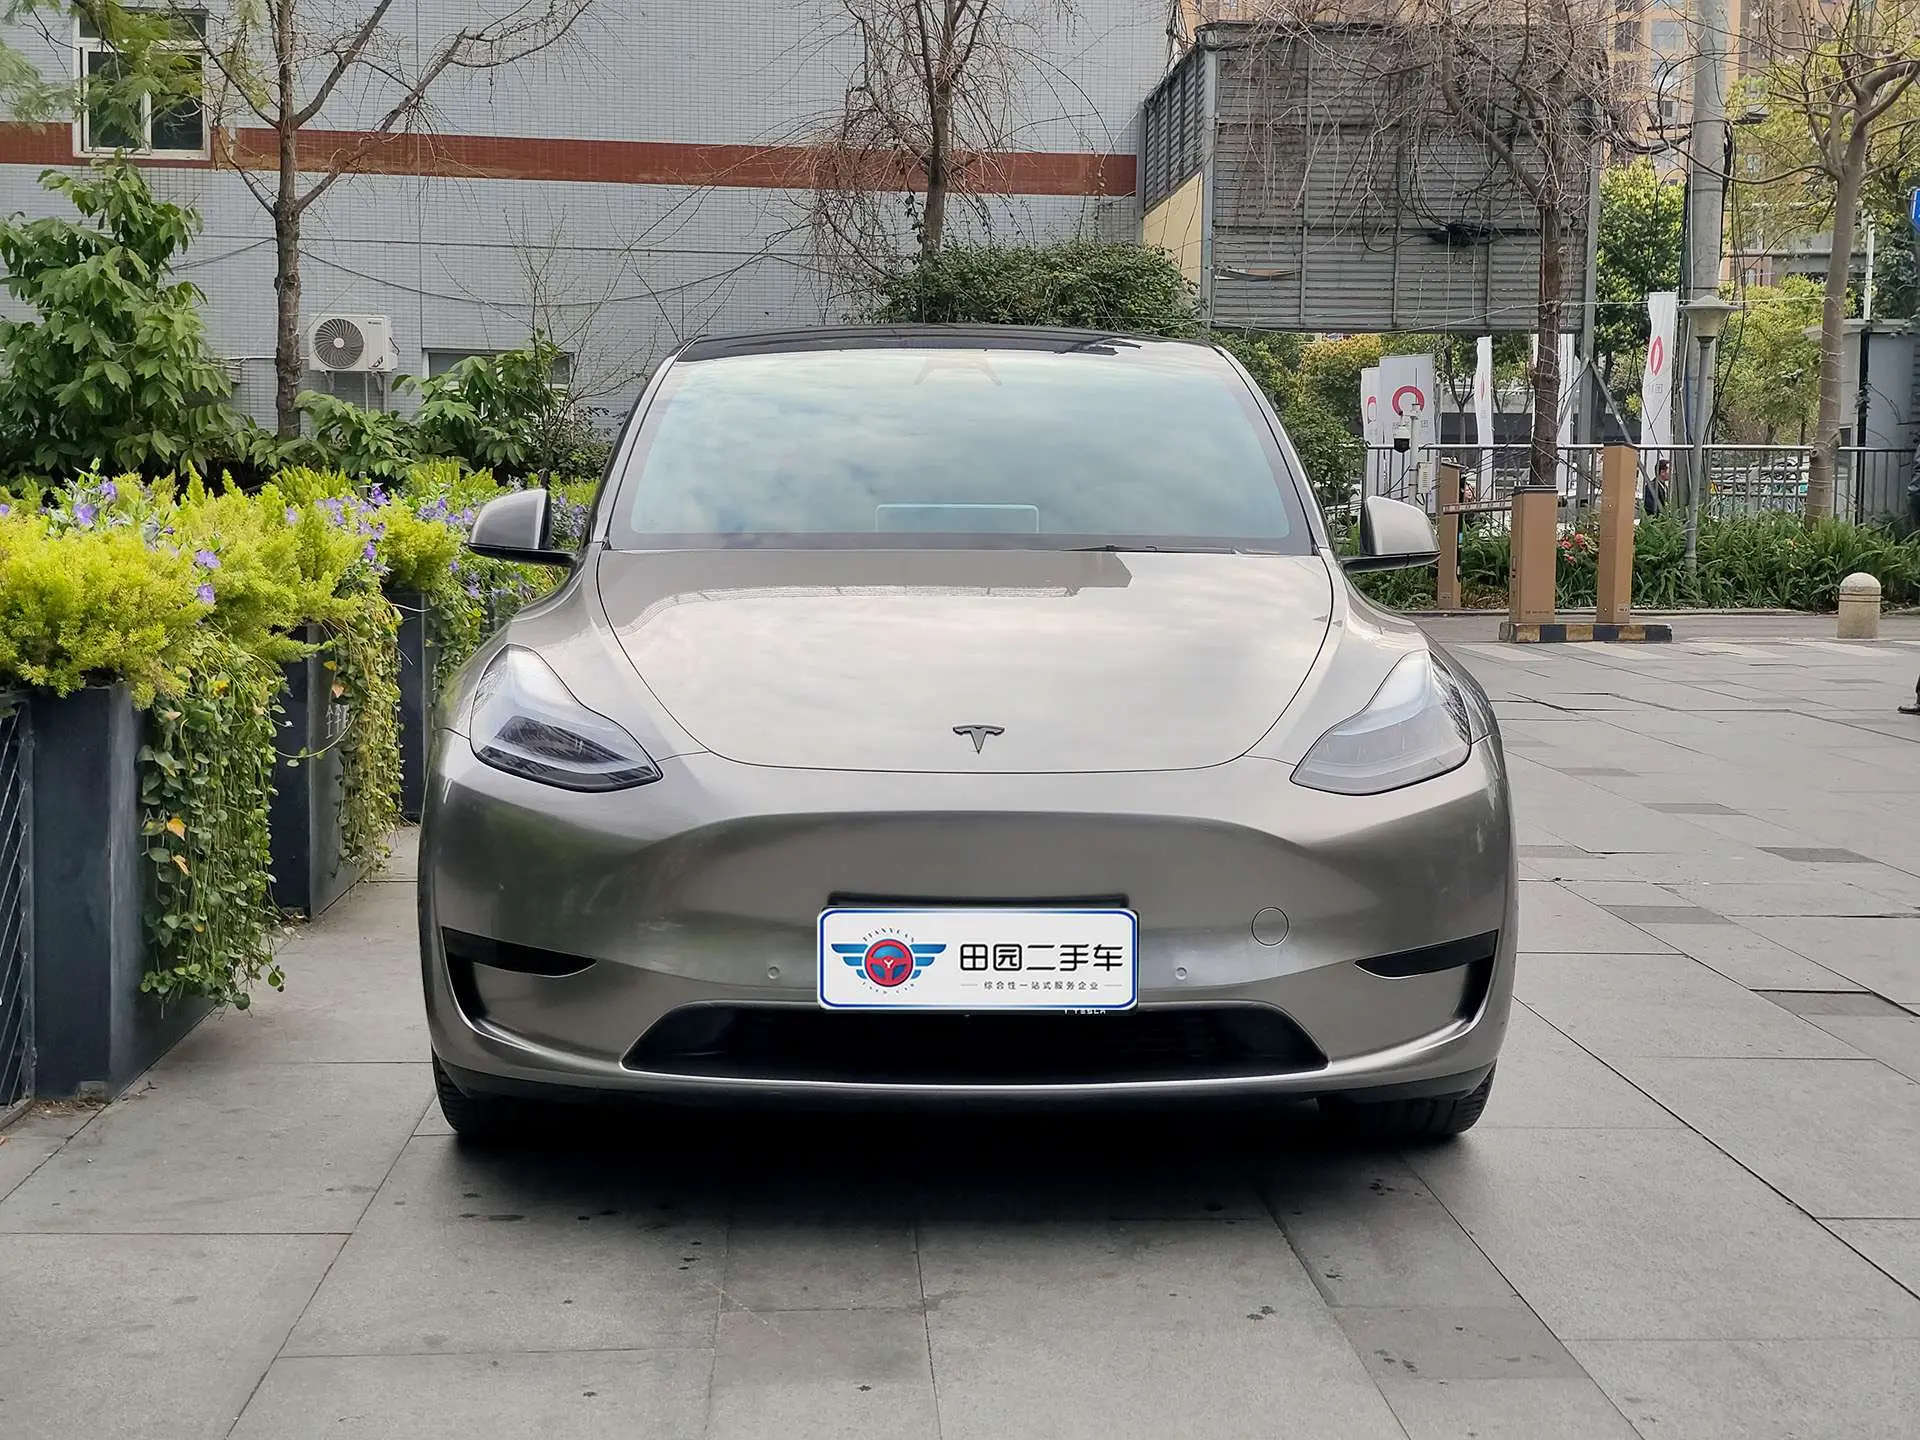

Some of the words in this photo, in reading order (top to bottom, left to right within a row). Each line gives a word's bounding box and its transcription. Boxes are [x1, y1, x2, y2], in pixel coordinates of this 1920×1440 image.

[960, 943, 1123, 972] 田园二手车
[984, 981, 1099, 991] 综合性一站式服务企业
